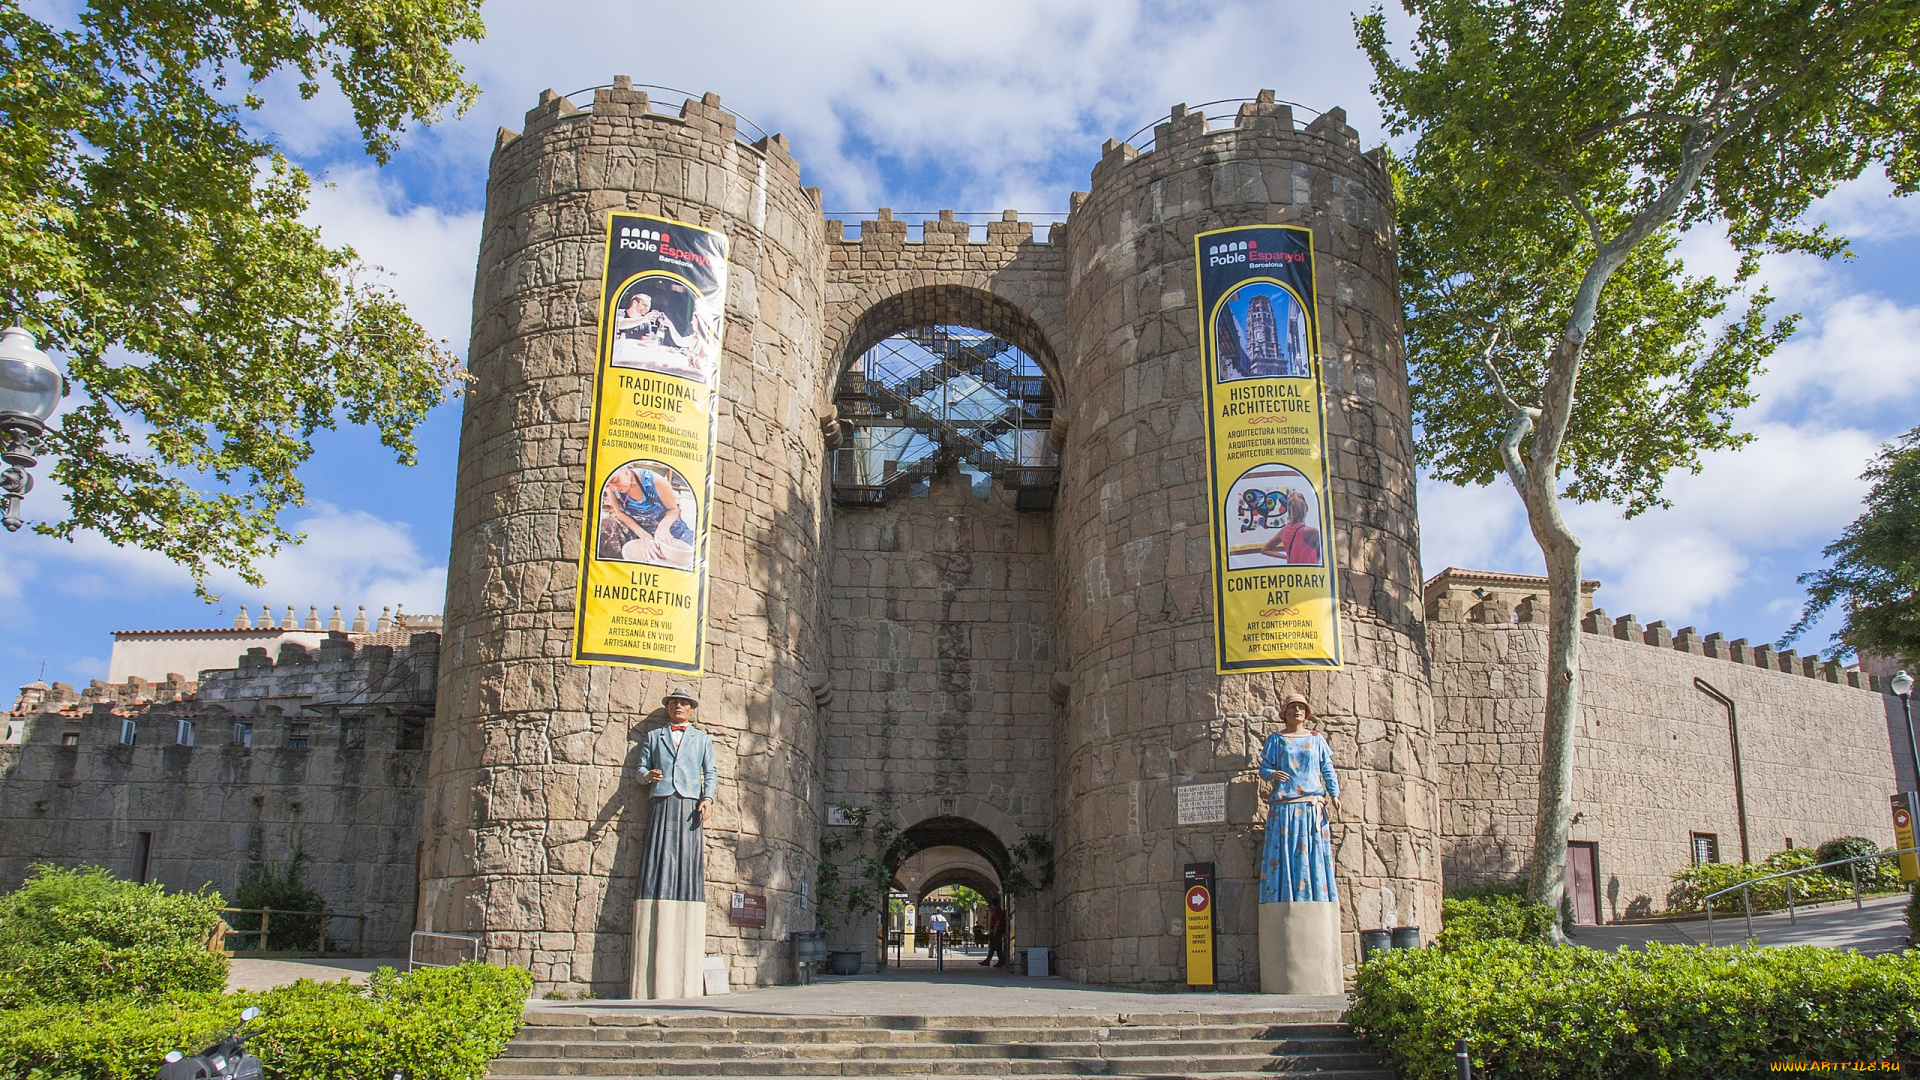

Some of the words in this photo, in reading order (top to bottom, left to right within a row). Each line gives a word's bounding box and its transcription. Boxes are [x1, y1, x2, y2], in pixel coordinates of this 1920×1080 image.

[620, 239, 657, 252] Poble
[659, 255, 693, 268] Barcelona
[1210, 253, 1246, 267] Poble
[1249, 251, 1304, 263] Espanyol
[619, 375, 697, 401] TRADITIONAL
[1230, 385, 1301, 401] HISTORICAL
[634, 393, 682, 413] CUISINE
[1222, 400, 1311, 417] ARCHITECTURE
[658, 424, 699, 440] TRADICIONAL
[1228, 427, 1275, 439] ARQUITECTURA
[602, 439, 648, 451] GASTRONOMIE
[651, 445, 703, 462] TRADITIONNELLE
[658, 436, 698, 451] TRADICIONAL
[1228, 438, 1275, 450] ARQUITECTURA
[1227, 448, 1274, 460] ARCHITECTURE
[1276, 448, 1311, 456] HISTORIQUE
[631, 571, 659, 587] LIVE
[1228, 574, 1325, 592] CONTEMPORARY
[594, 585, 691, 609] HANDCRAFTING
[1267, 591, 1290, 605] ART
[651, 620, 659, 628] EN
[661, 621, 672, 630] VIU
[1247, 622, 1259, 630] ART
[1262, 620, 1312, 629] CONTEMPORANI
[648, 631, 656, 639] EN
[658, 632, 673, 642] VIVO
[1243, 634, 1259, 642] ARTE
[1261, 630, 1318, 641] CONTEMPORÁNEO
[604, 638, 640, 648] ARTISANAT
[642, 642, 651, 650] EN
[653, 644, 676, 653] DIRECT
[1249, 644, 1260, 652] ART
[1263, 643, 1313, 651] CONTEMPORAIN
